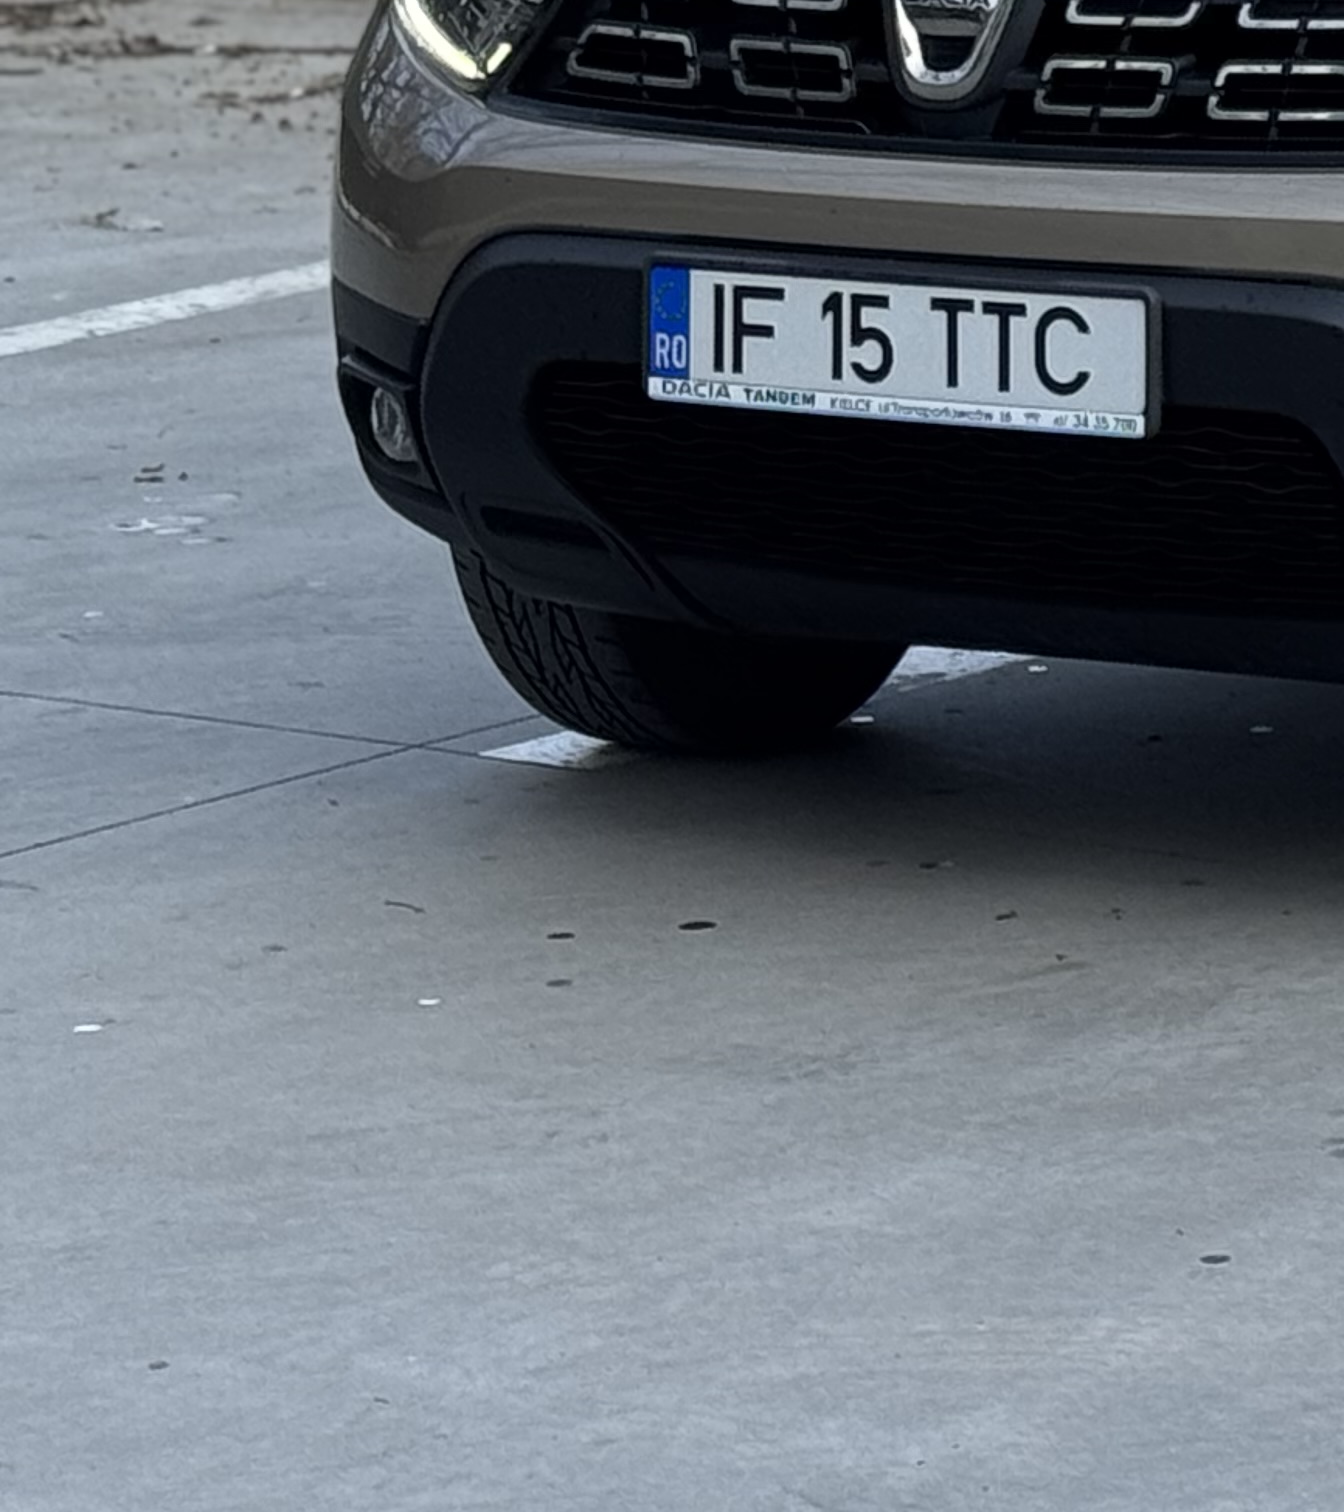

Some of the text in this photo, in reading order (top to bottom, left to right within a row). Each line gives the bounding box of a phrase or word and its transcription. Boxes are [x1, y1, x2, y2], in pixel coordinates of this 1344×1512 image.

[655, 332, 687, 369] RO
[712, 282, 1092, 397] IF 15 TTC
[661, 379, 732, 400] DACIA
[742, 387, 817, 408] TANDEM
